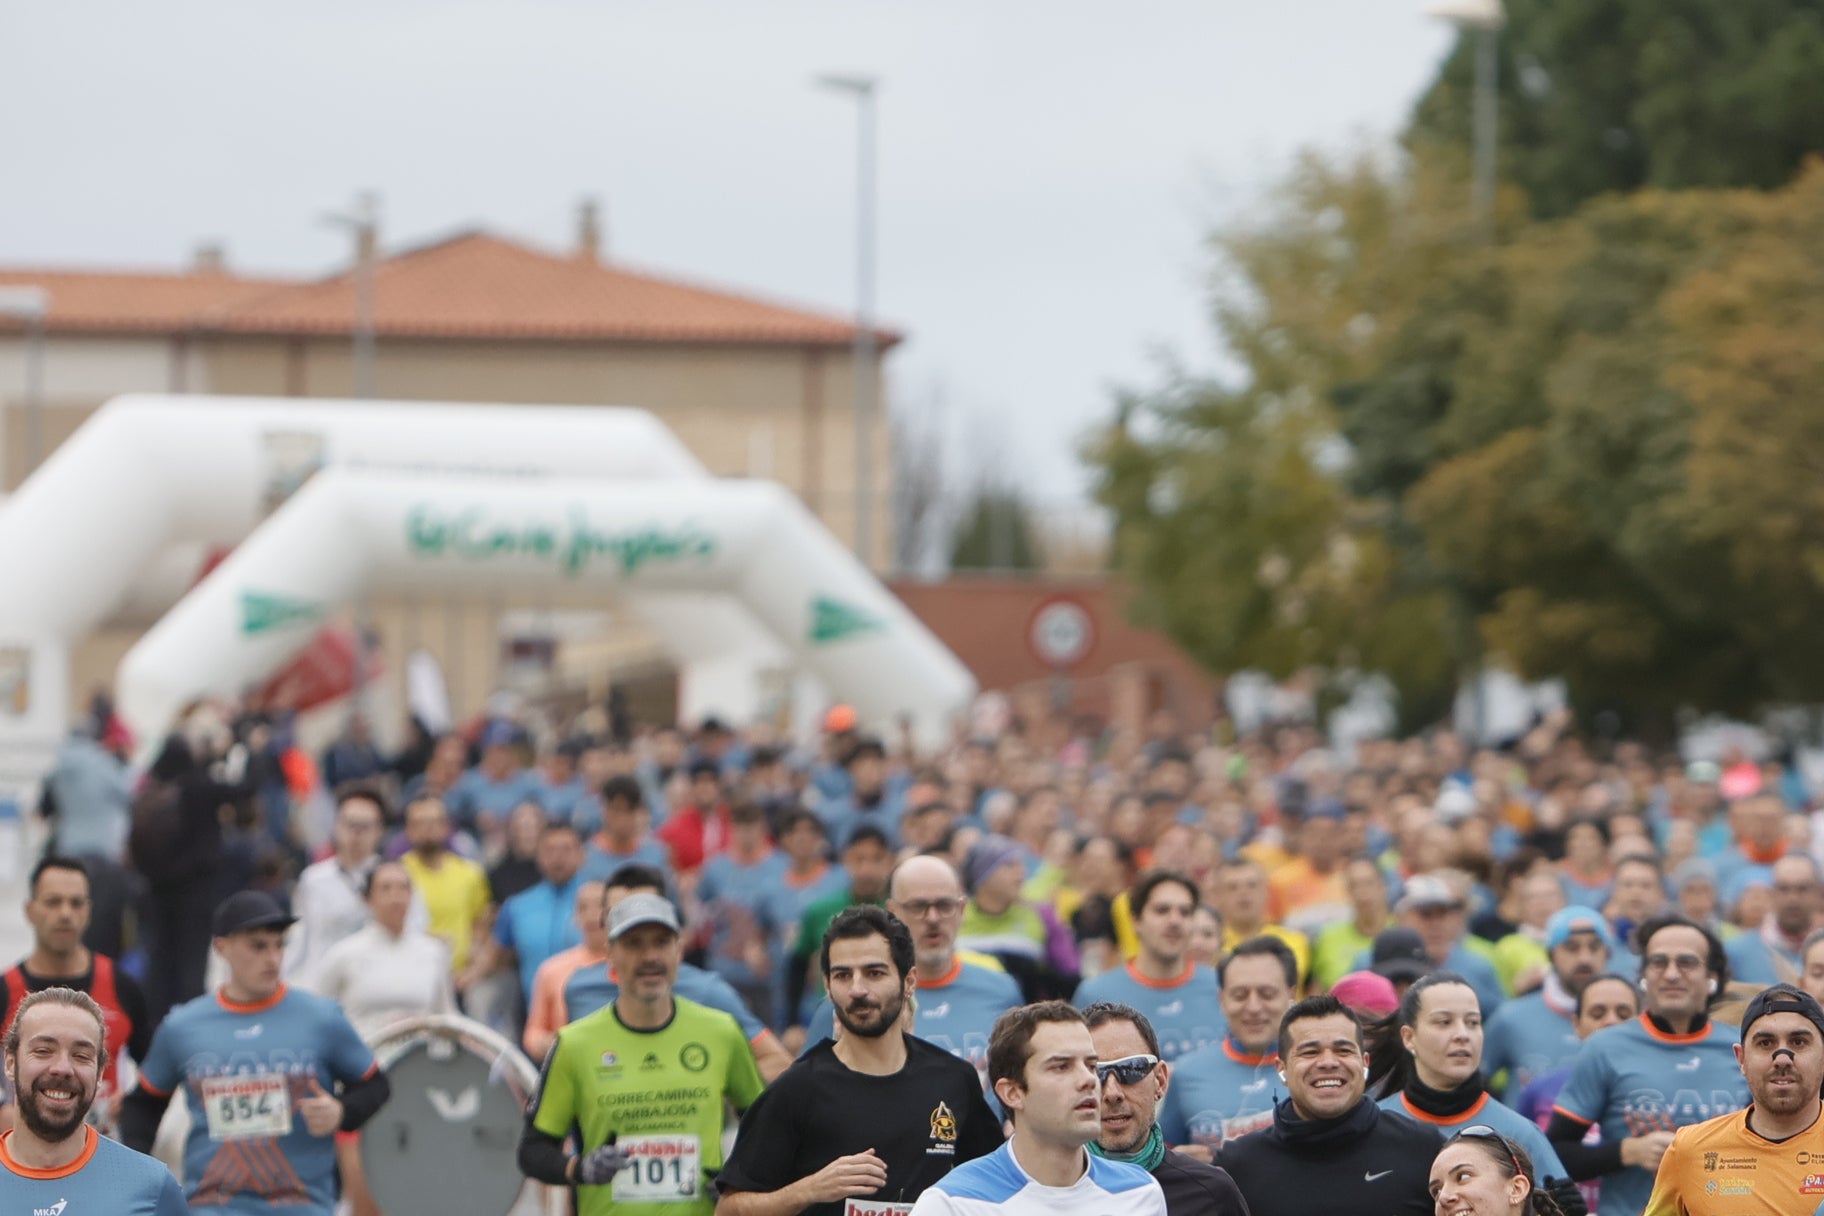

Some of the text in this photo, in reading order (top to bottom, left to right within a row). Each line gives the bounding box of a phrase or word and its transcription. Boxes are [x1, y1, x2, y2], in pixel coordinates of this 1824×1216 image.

[597, 1086, 711, 1107] CORRECAMINOS
[611, 1103, 698, 1122] CARBAJOSA
[631, 1157, 682, 1185] 101
